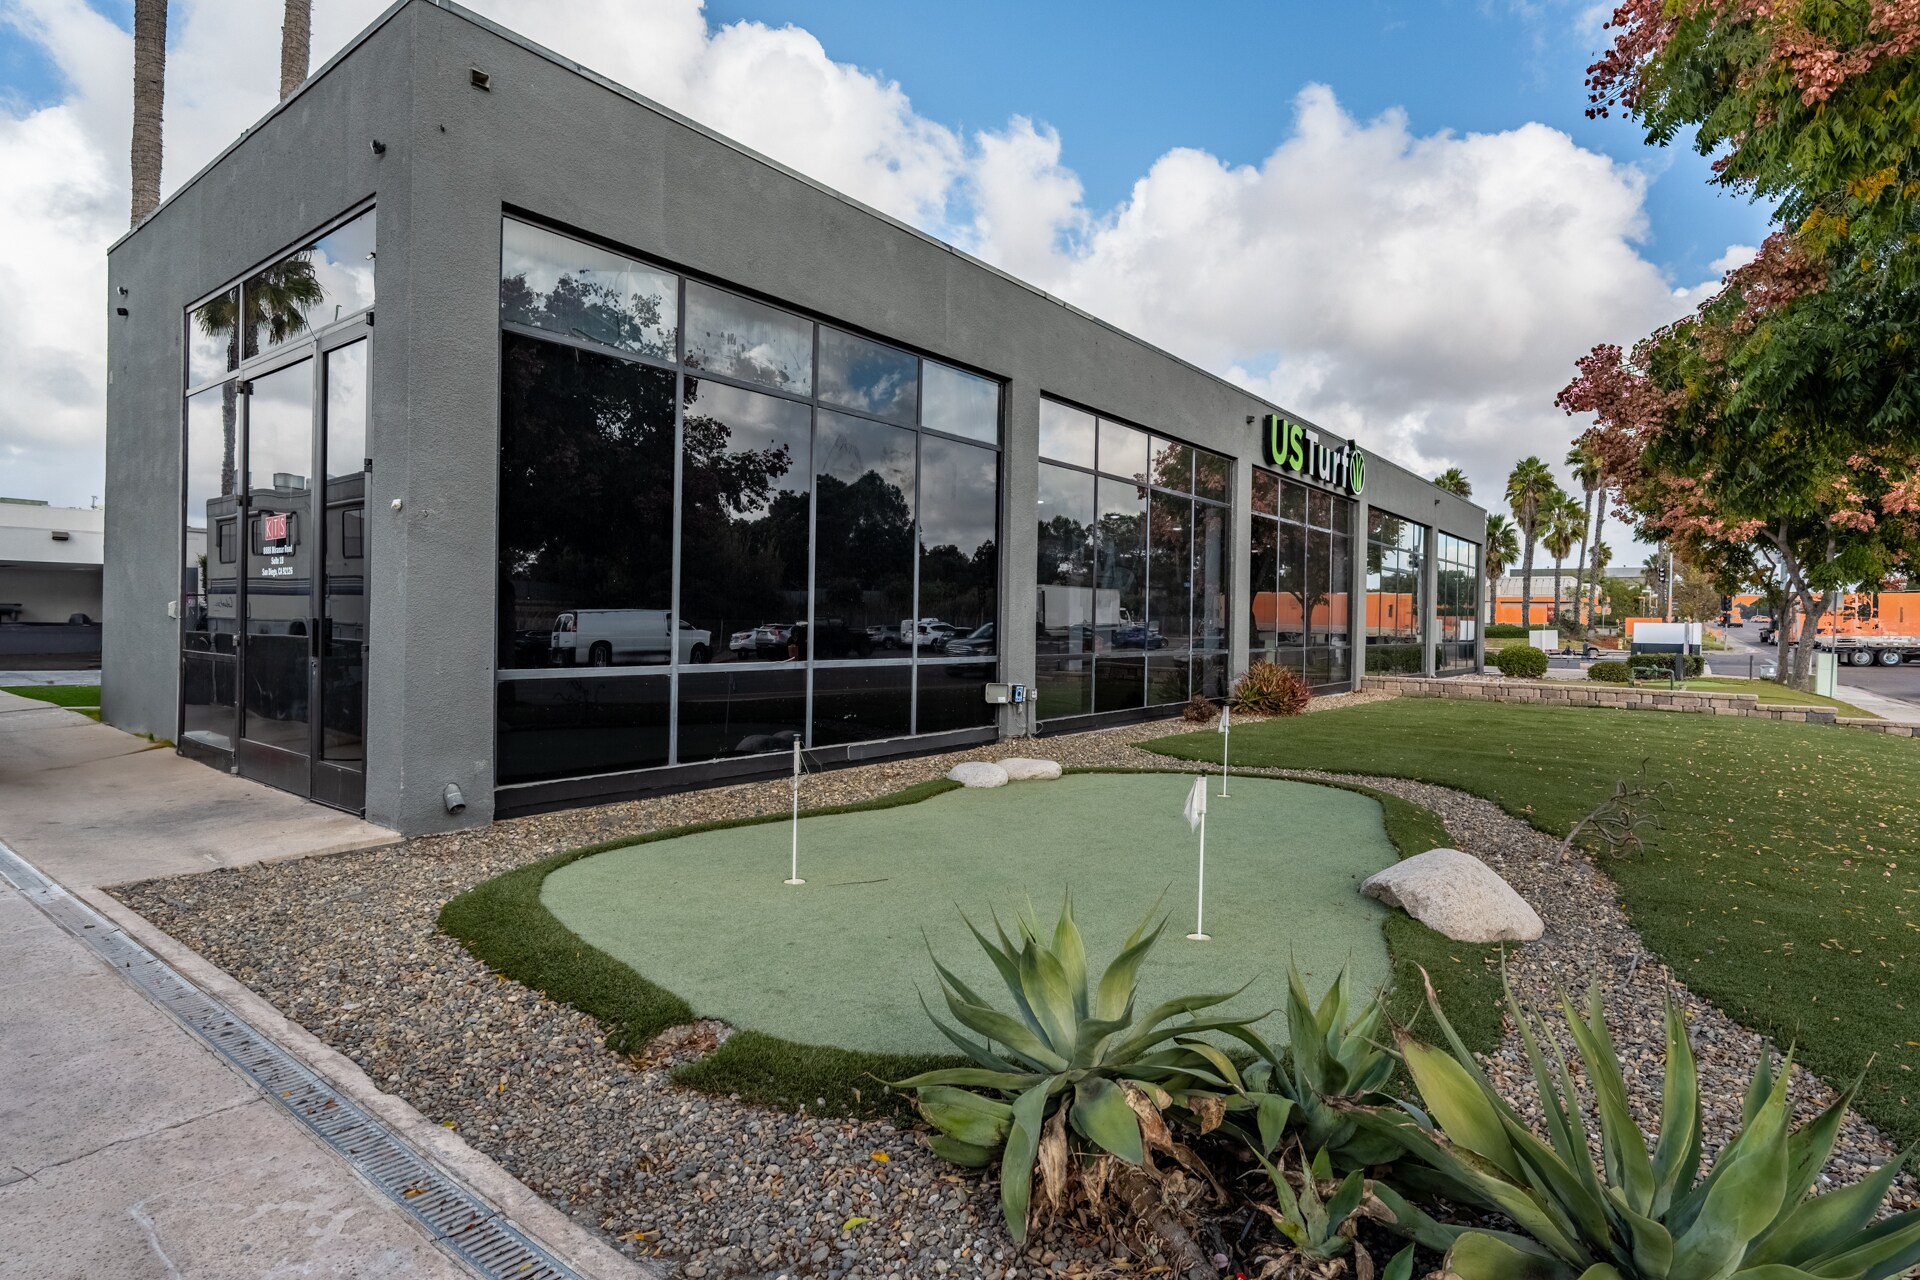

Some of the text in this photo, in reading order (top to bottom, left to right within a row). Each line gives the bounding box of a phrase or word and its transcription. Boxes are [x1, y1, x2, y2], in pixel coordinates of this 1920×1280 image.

[266, 516, 286, 538] KTS
[284, 544, 293, 553] Road
[271, 556, 279, 565] Suite
